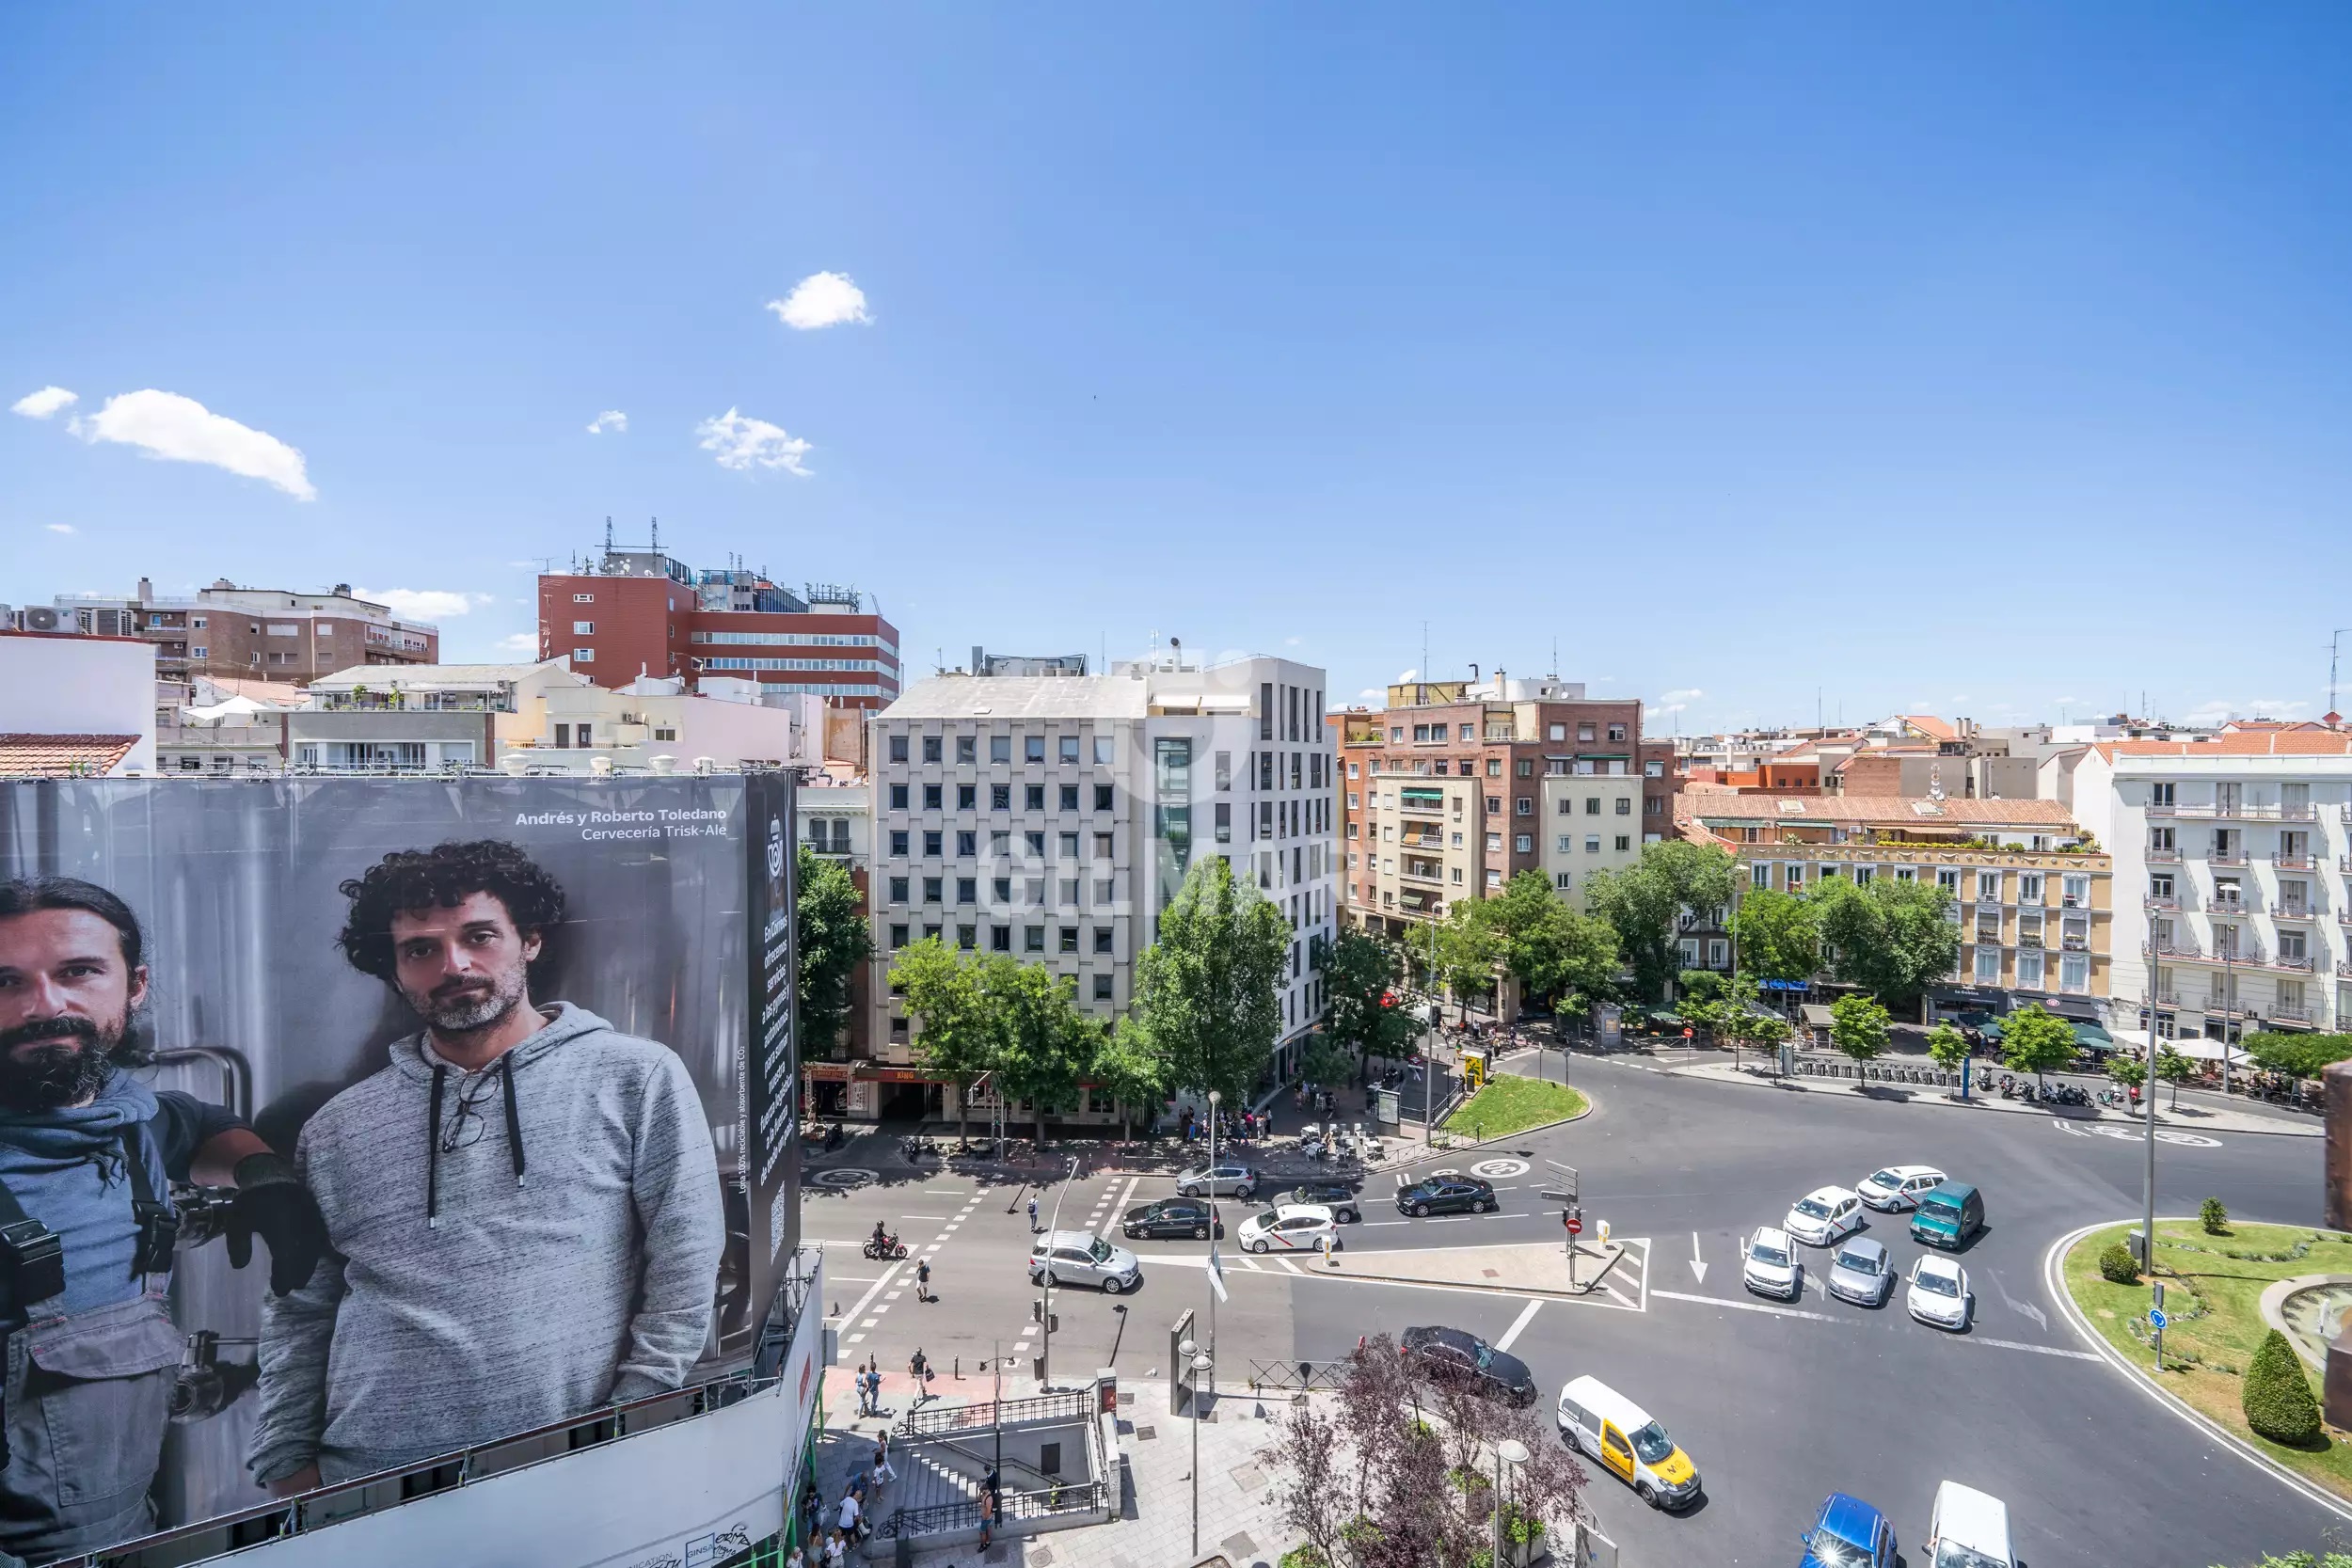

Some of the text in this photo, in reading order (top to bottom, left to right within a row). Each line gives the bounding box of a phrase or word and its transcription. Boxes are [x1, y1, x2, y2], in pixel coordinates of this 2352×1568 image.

[516, 809, 727, 826] Andrés y Roberto Toledano
[581, 824, 727, 841] Cervecería Trisk-Ale
[764, 927, 771, 943] En
[764, 939, 787, 970] ofrecemos
[767, 963, 787, 993] servicios
[738, 1060, 745, 1070] de
[738, 1071, 746, 1113] absorbente
[738, 1119, 746, 1153] reciclable
[687, 1544, 713, 1559] GINSA
